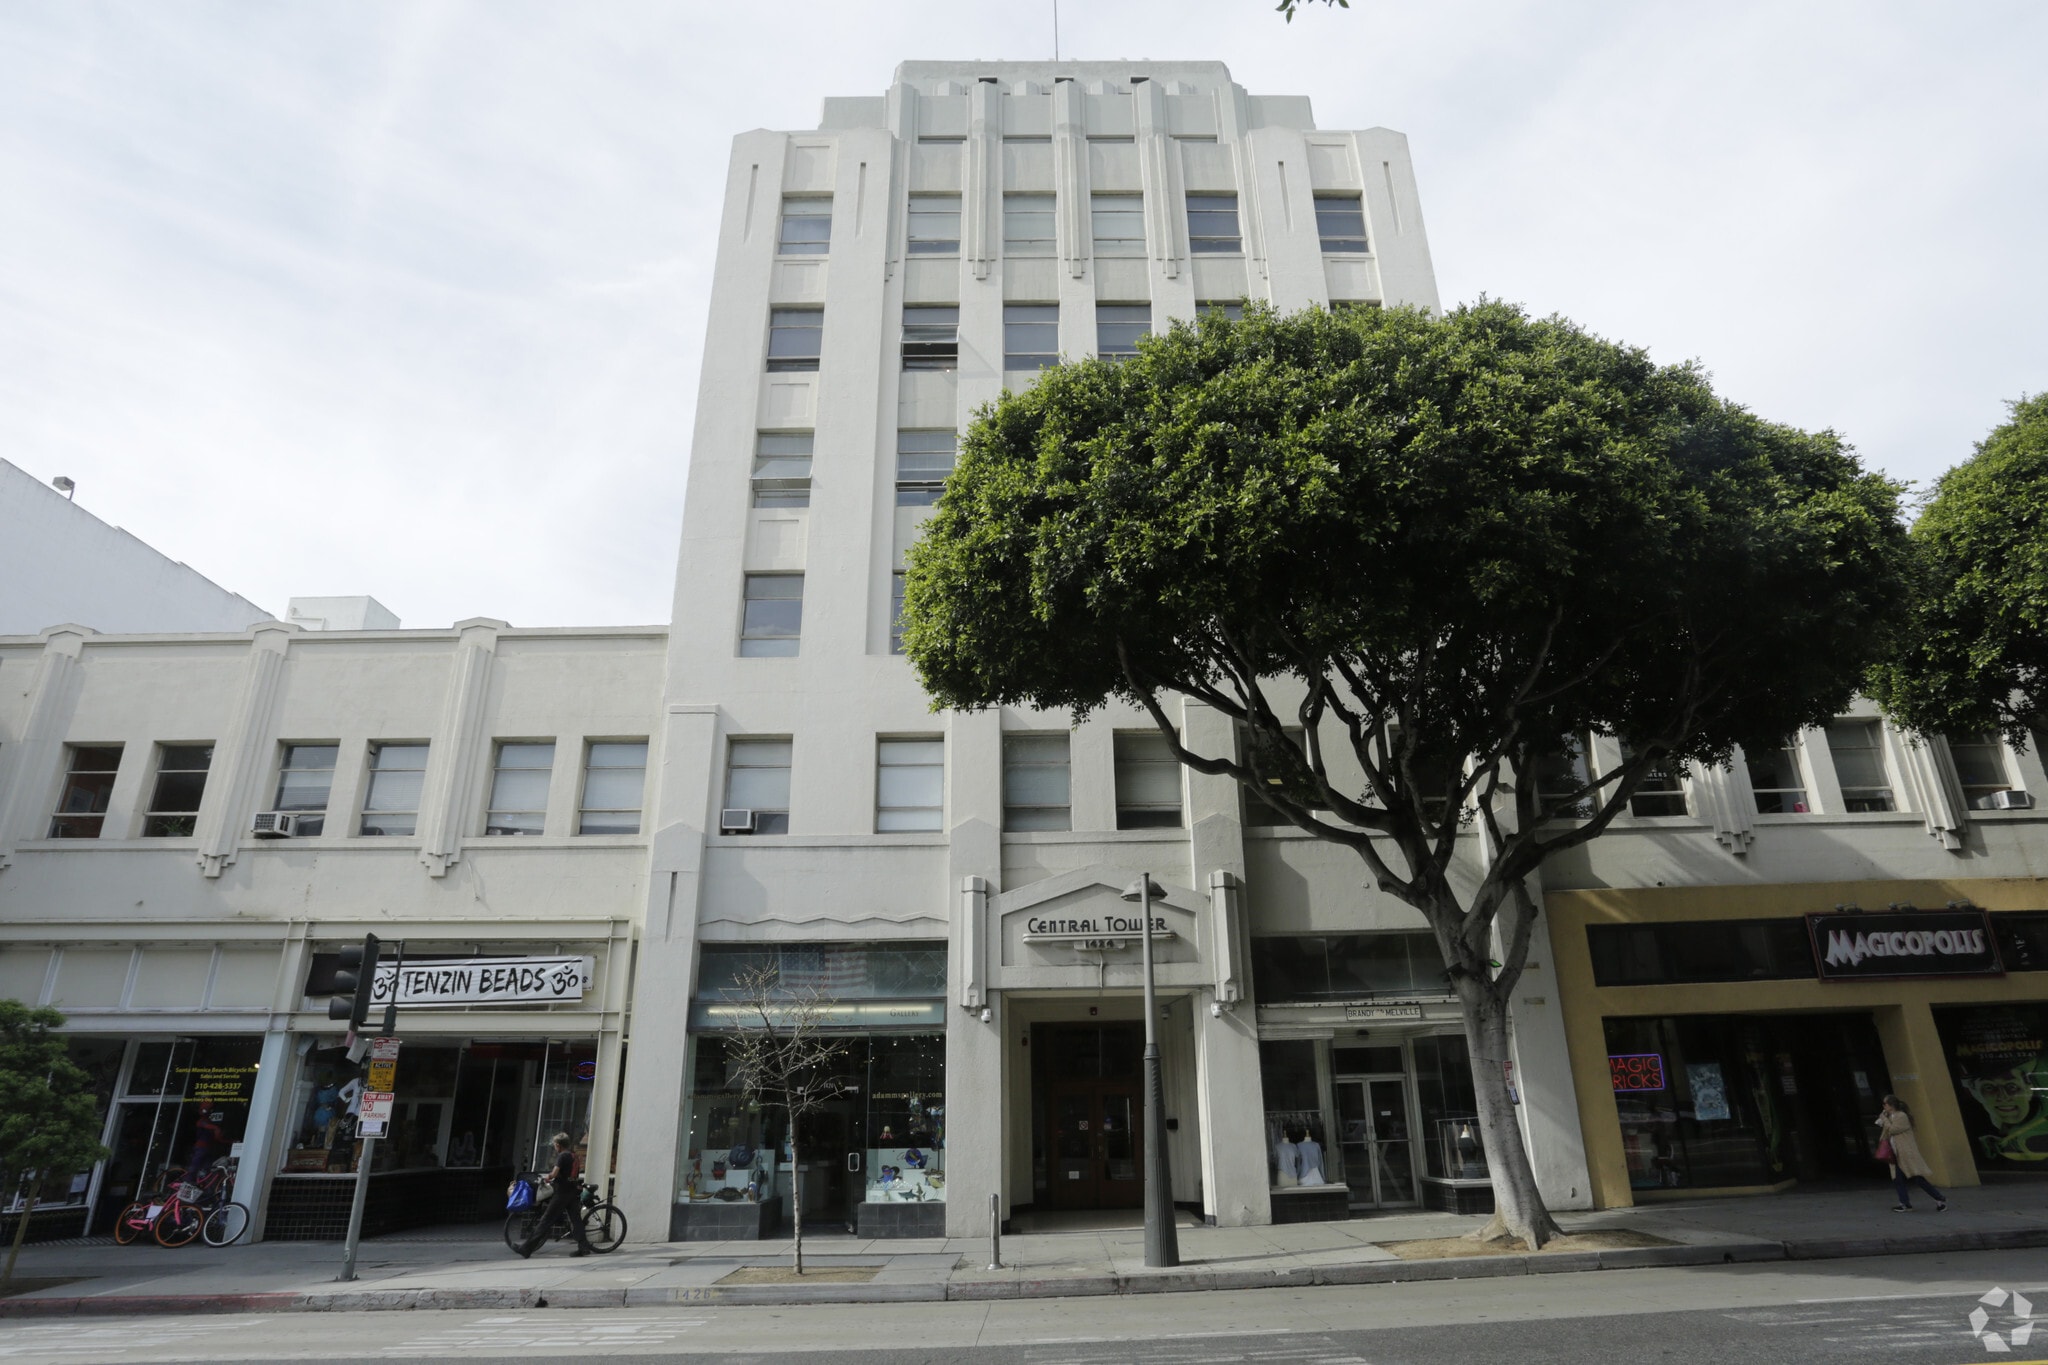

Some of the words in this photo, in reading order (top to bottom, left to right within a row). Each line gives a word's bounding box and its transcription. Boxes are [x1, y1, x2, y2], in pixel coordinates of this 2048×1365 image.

[1028, 917, 1099, 933] CENTRAL
[1085, 940, 1115, 949] 1424
[1824, 928, 1986, 967] MAGICOPOLIS
[403, 969, 472, 997] TENZIN
[479, 968, 546, 995] BEADS
[1348, 1009, 1375, 1017] BRANDY
[1385, 1007, 1419, 1016] MELVILLE
[1612, 1073, 1661, 1088] RICKS
[363, 1102, 373, 1111] NO
[675, 1288, 711, 1300] 1426
